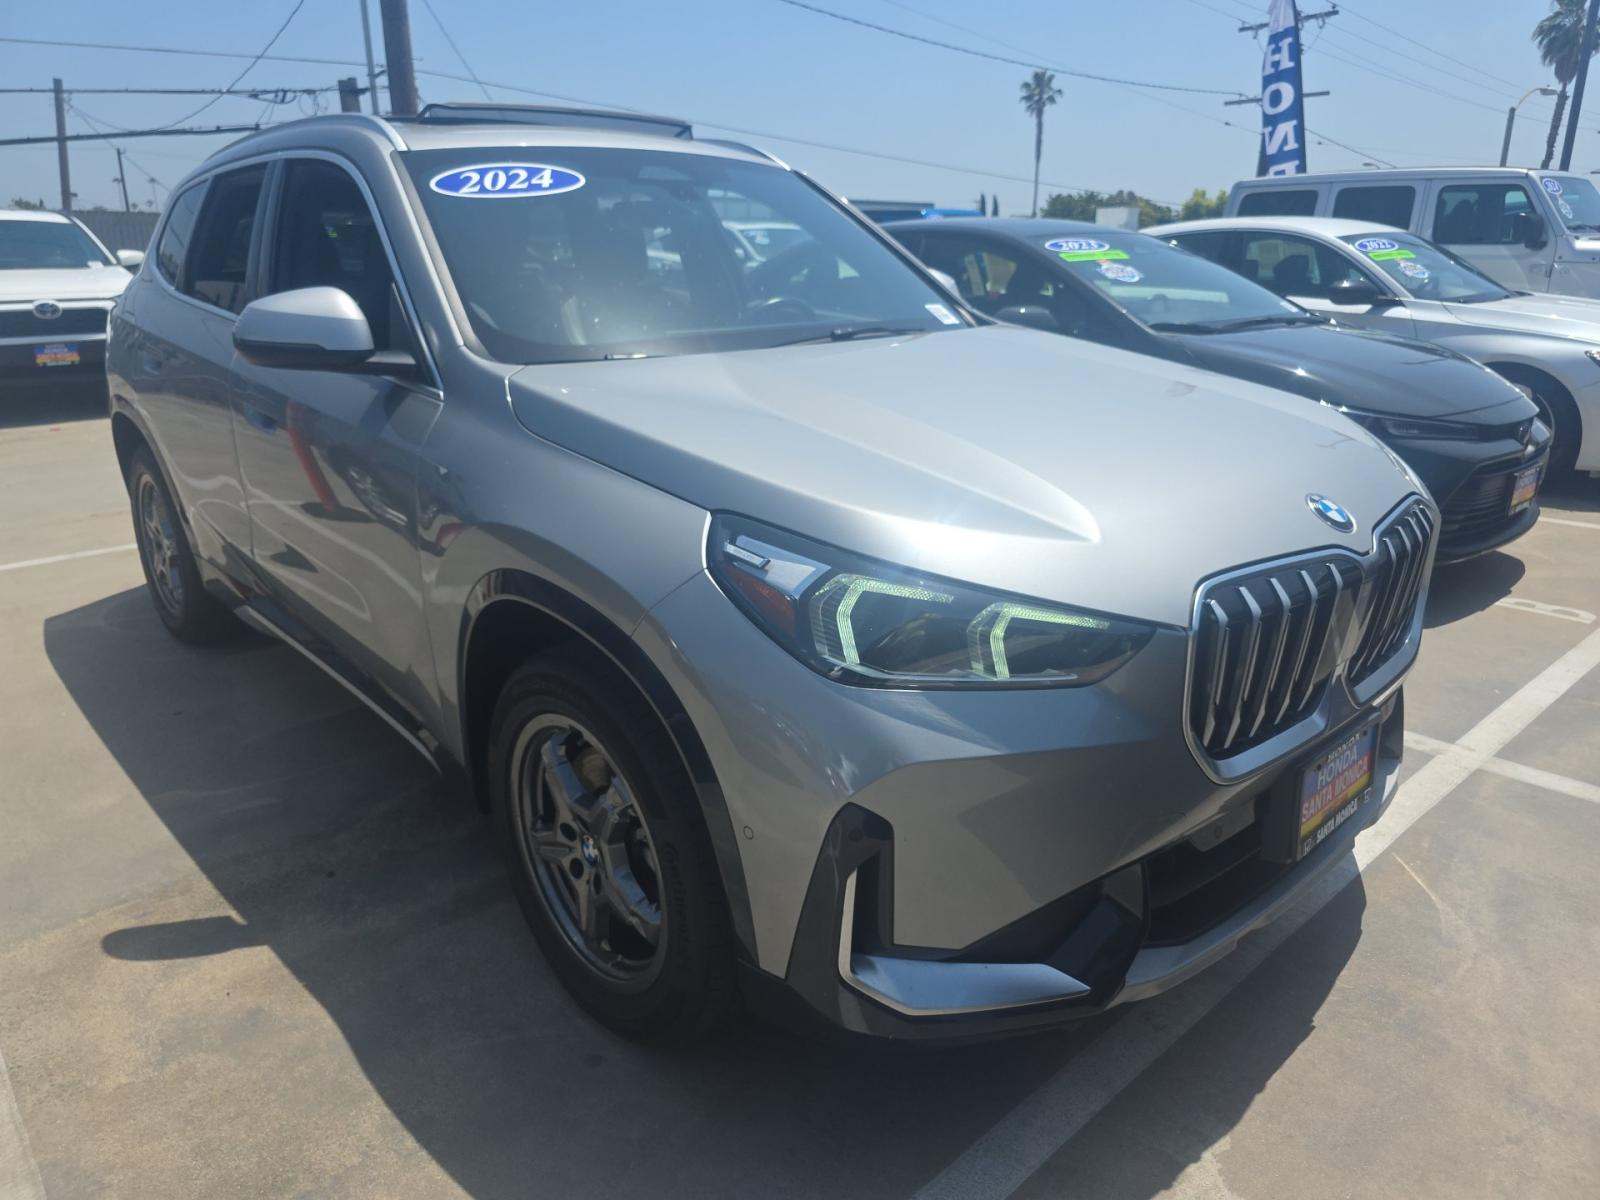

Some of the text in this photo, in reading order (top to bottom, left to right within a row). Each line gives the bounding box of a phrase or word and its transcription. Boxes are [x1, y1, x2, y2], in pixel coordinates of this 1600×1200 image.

[458, 168, 554, 194] 2024
[1301, 752, 1370, 823] SANTA MONICA
[1317, 744, 1358, 790] HONDA
[1316, 798, 1358, 844] SANTA MONICA
